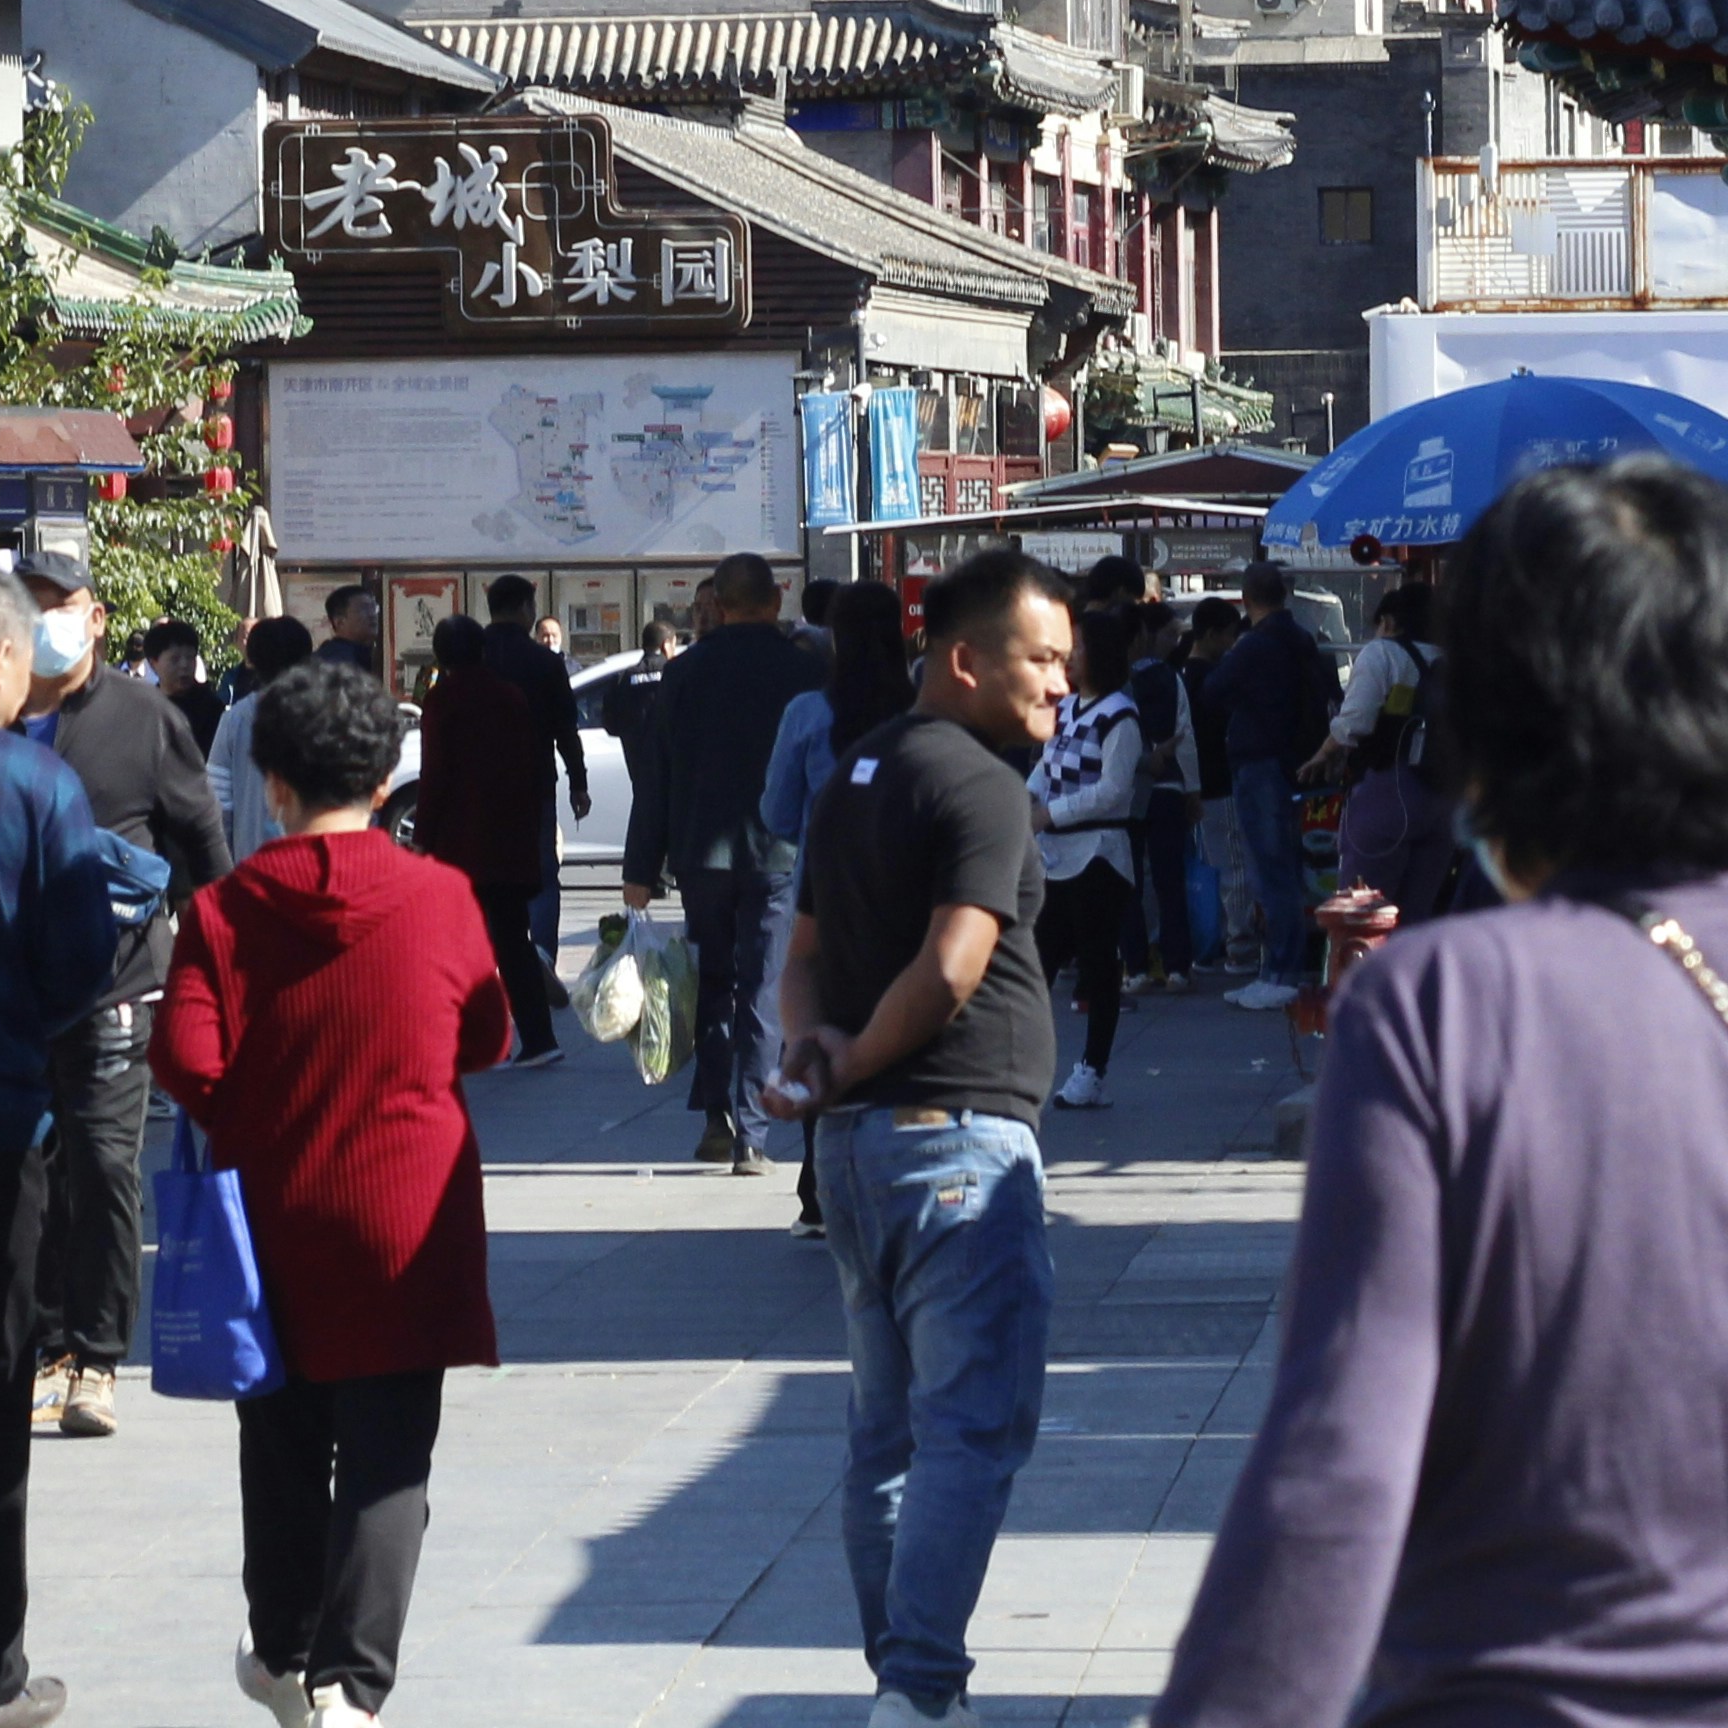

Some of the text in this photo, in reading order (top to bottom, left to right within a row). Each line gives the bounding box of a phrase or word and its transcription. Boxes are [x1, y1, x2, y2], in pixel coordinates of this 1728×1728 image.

[304, 144, 524, 246] 老城
[472, 237, 729, 308] 小梨园
[1339, 512, 1462, 541] 宝矿力水特
